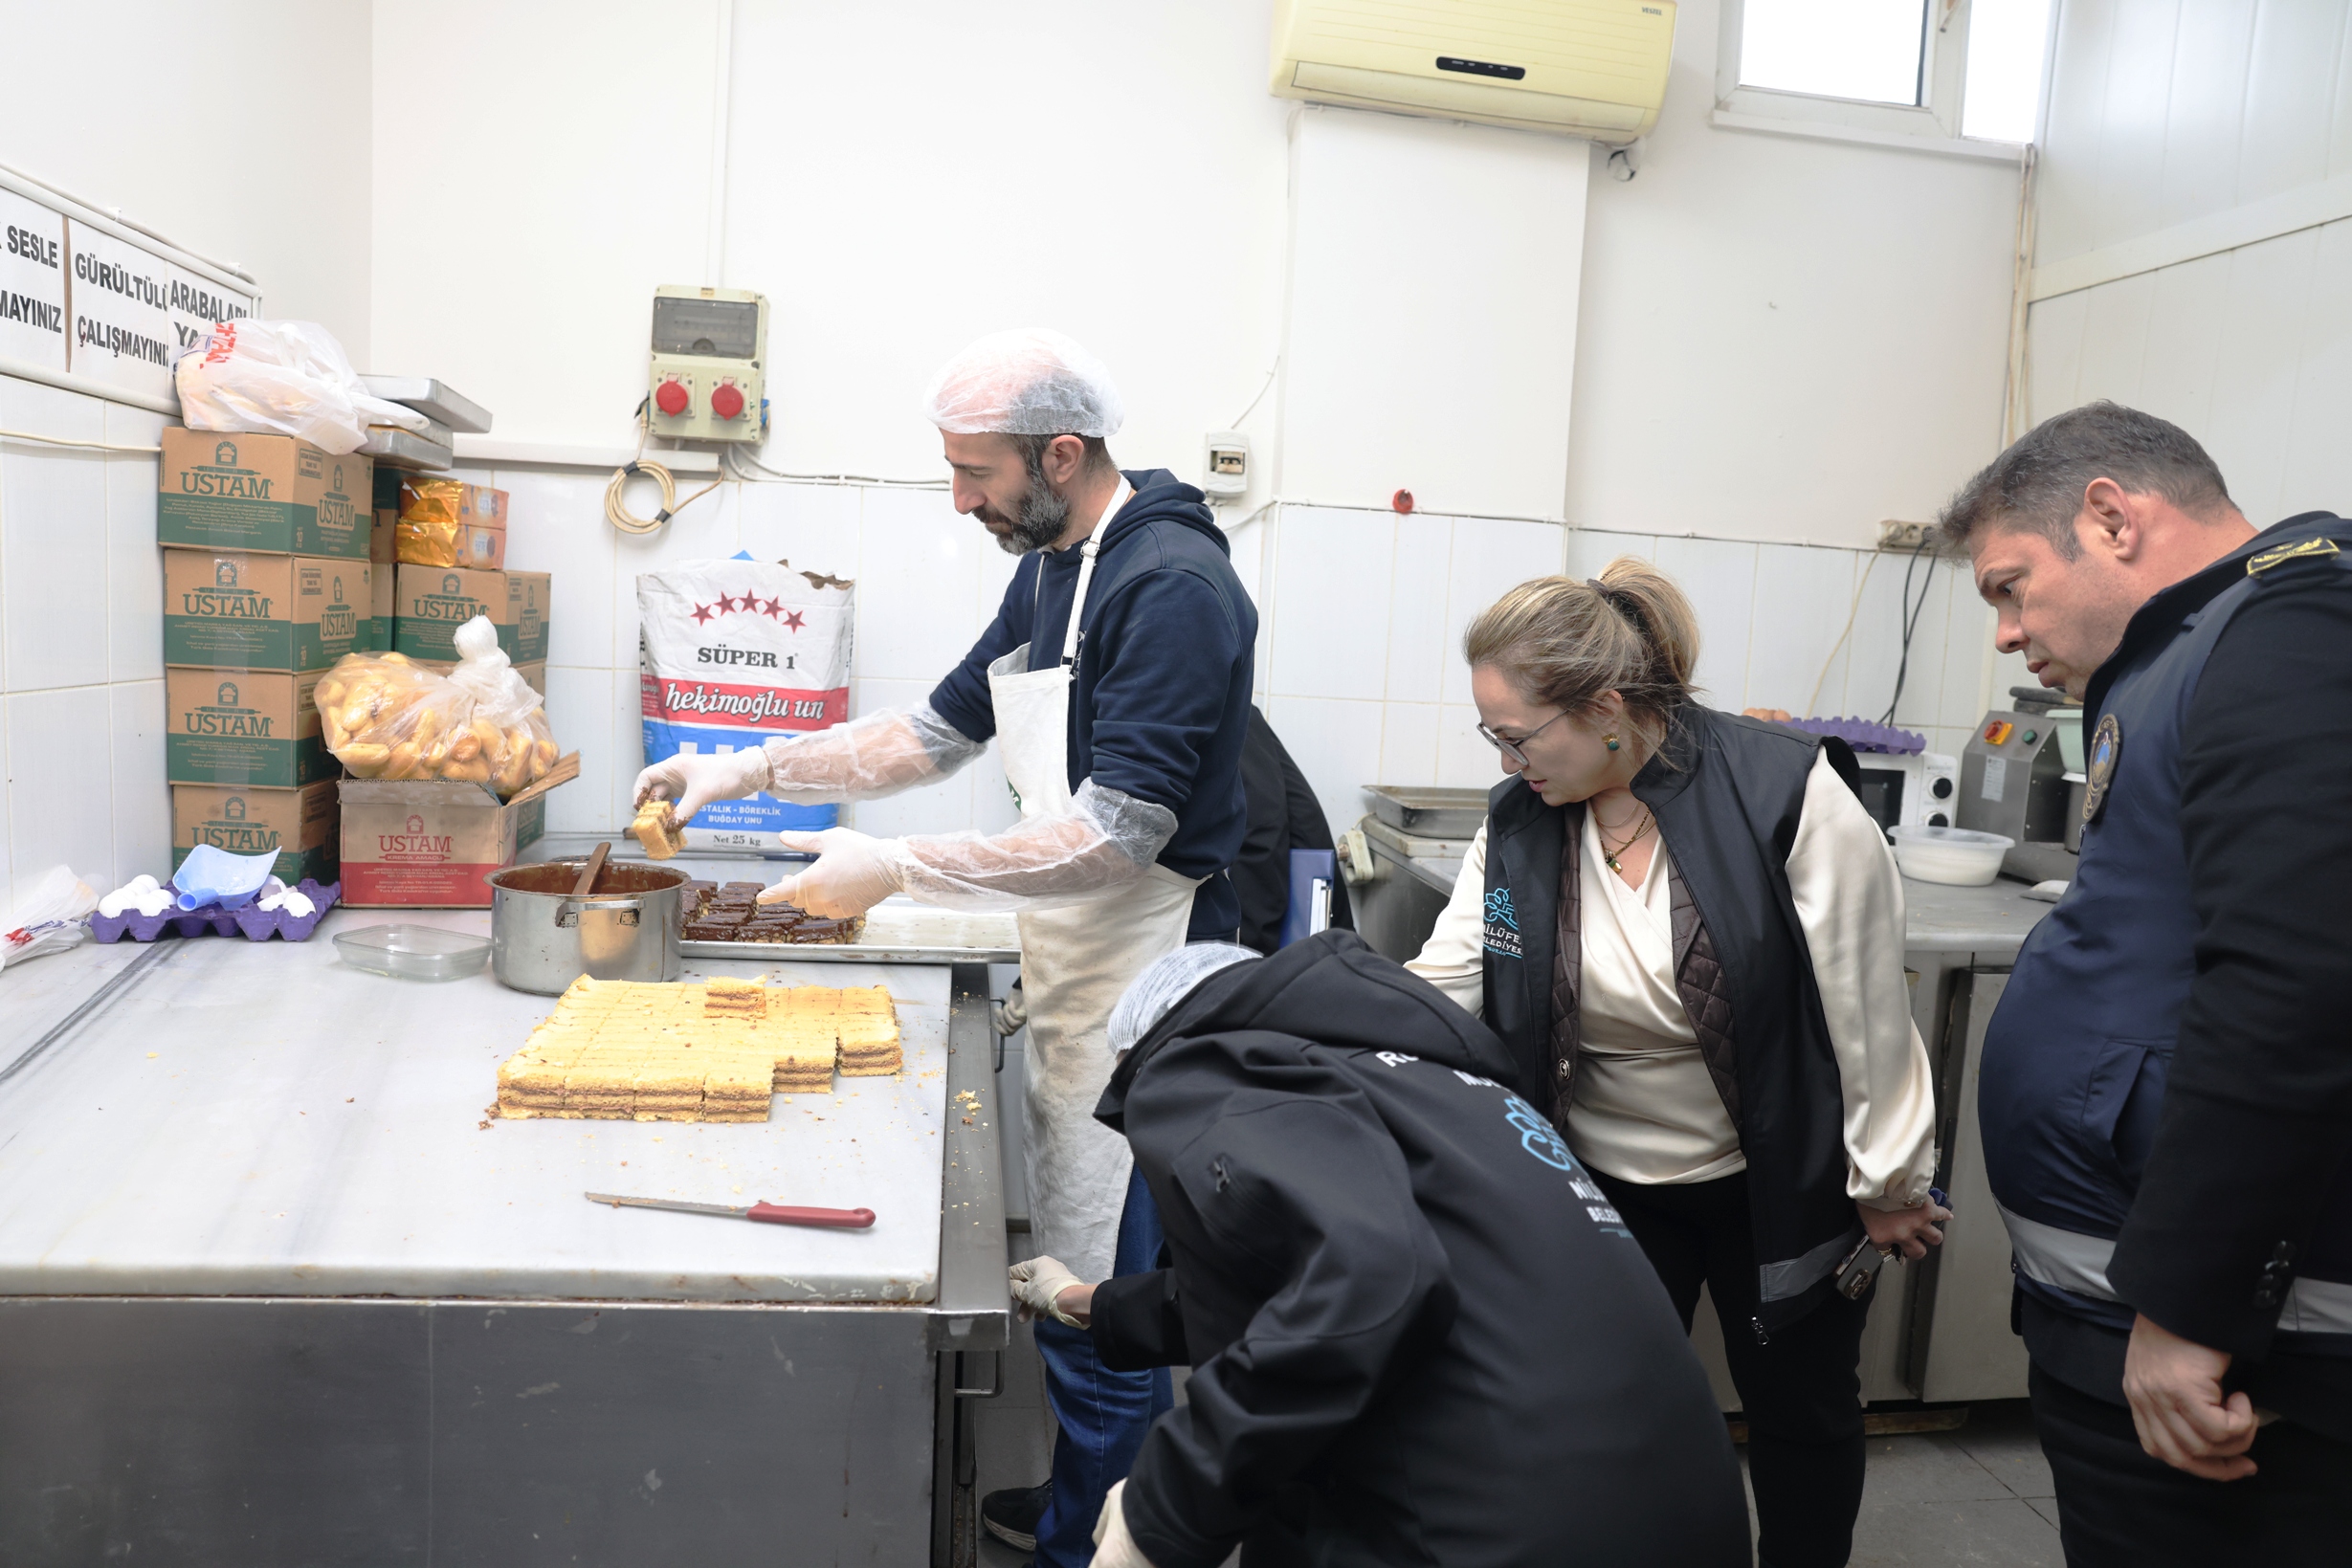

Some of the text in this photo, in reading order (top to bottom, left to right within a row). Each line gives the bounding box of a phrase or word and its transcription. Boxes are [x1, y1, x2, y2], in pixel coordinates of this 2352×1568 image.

[7, 225, 58, 270] SESLE
[180, 472, 271, 499] USTAM
[319, 499, 355, 527] USTAM
[183, 593, 271, 618] USTAM
[322, 612, 356, 637] USTAM
[698, 643, 796, 670] SÜPER 1
[664, 682, 790, 723] hekimoğlu
[793, 698, 826, 721] un
[185, 713, 271, 737] USTAM
[699, 805, 732, 814] STALIK
[739, 806, 782, 816] BÖREKLİK
[708, 814, 763, 825] BUĞDAY UNU
[191, 827, 279, 850] USTAM
[378, 835, 453, 852] USTAM
[713, 834, 762, 847] Net 25 kg
[1483, 923, 1522, 945] İLÜFE
[1483, 936, 1523, 956] LEDİYES
